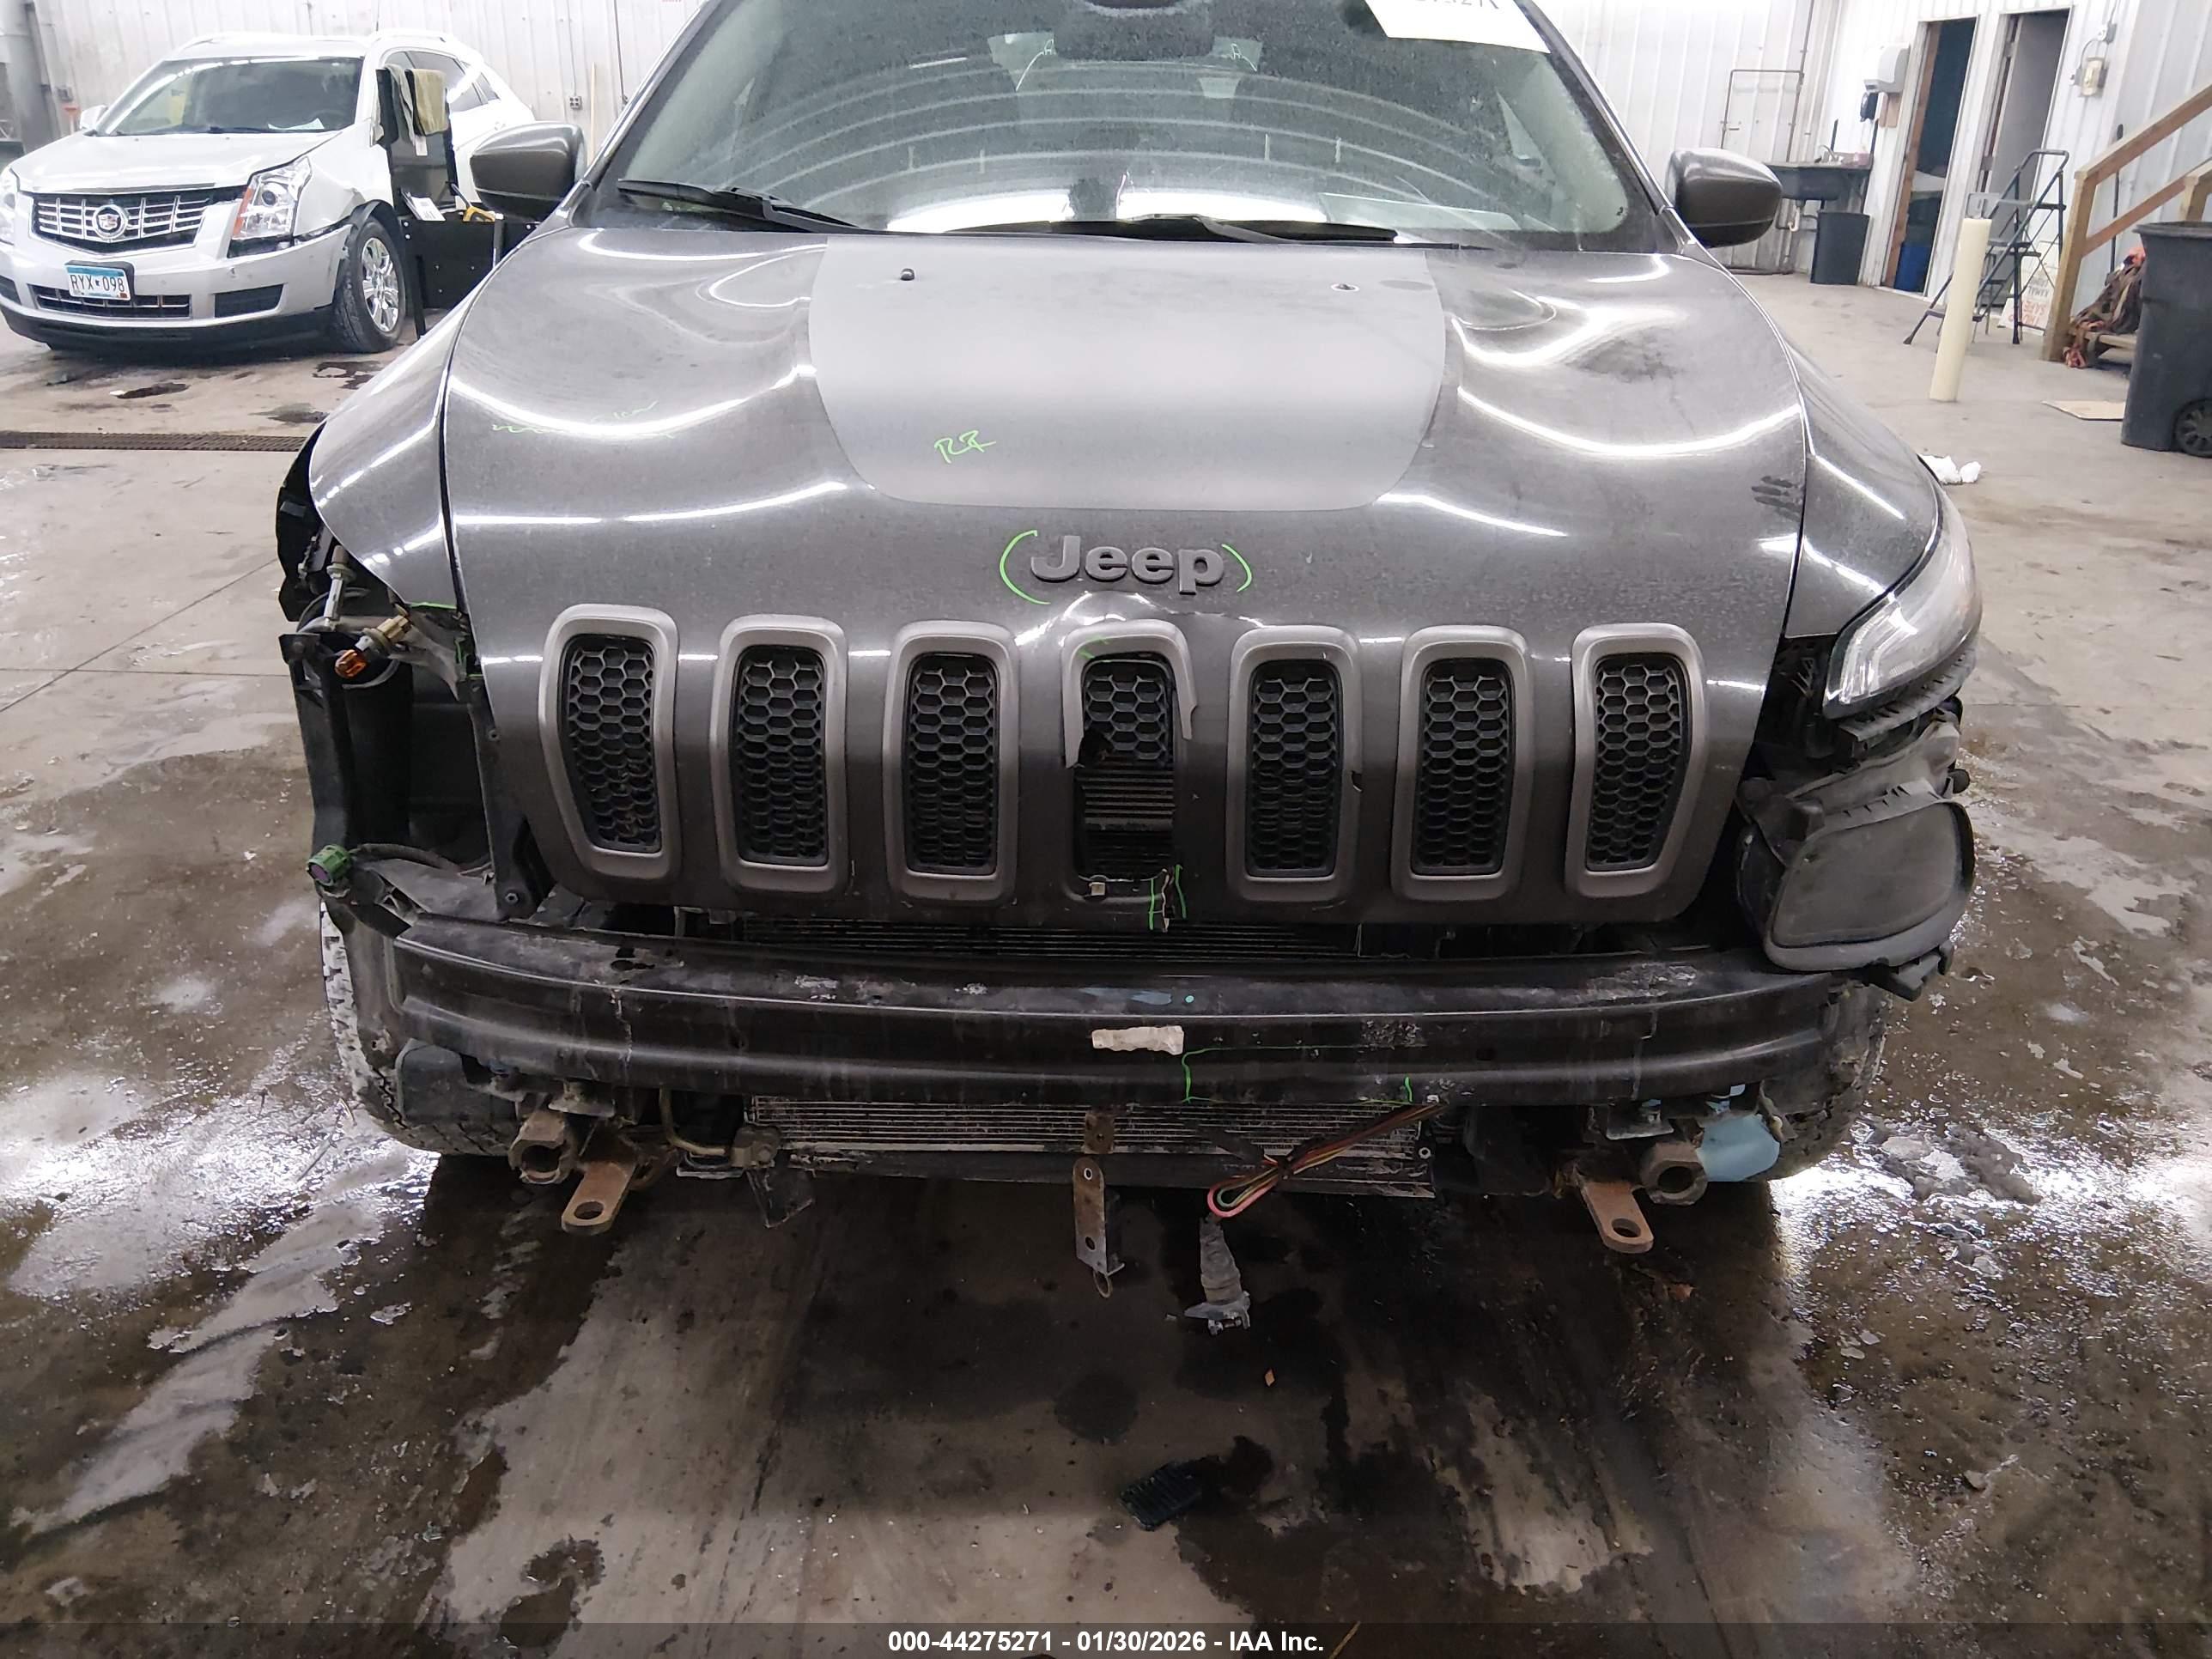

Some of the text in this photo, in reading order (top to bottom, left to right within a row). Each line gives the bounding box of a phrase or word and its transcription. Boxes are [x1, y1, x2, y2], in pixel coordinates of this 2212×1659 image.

[70, 274, 125, 292] RYX 098
[1030, 535, 1224, 595] Jeep
